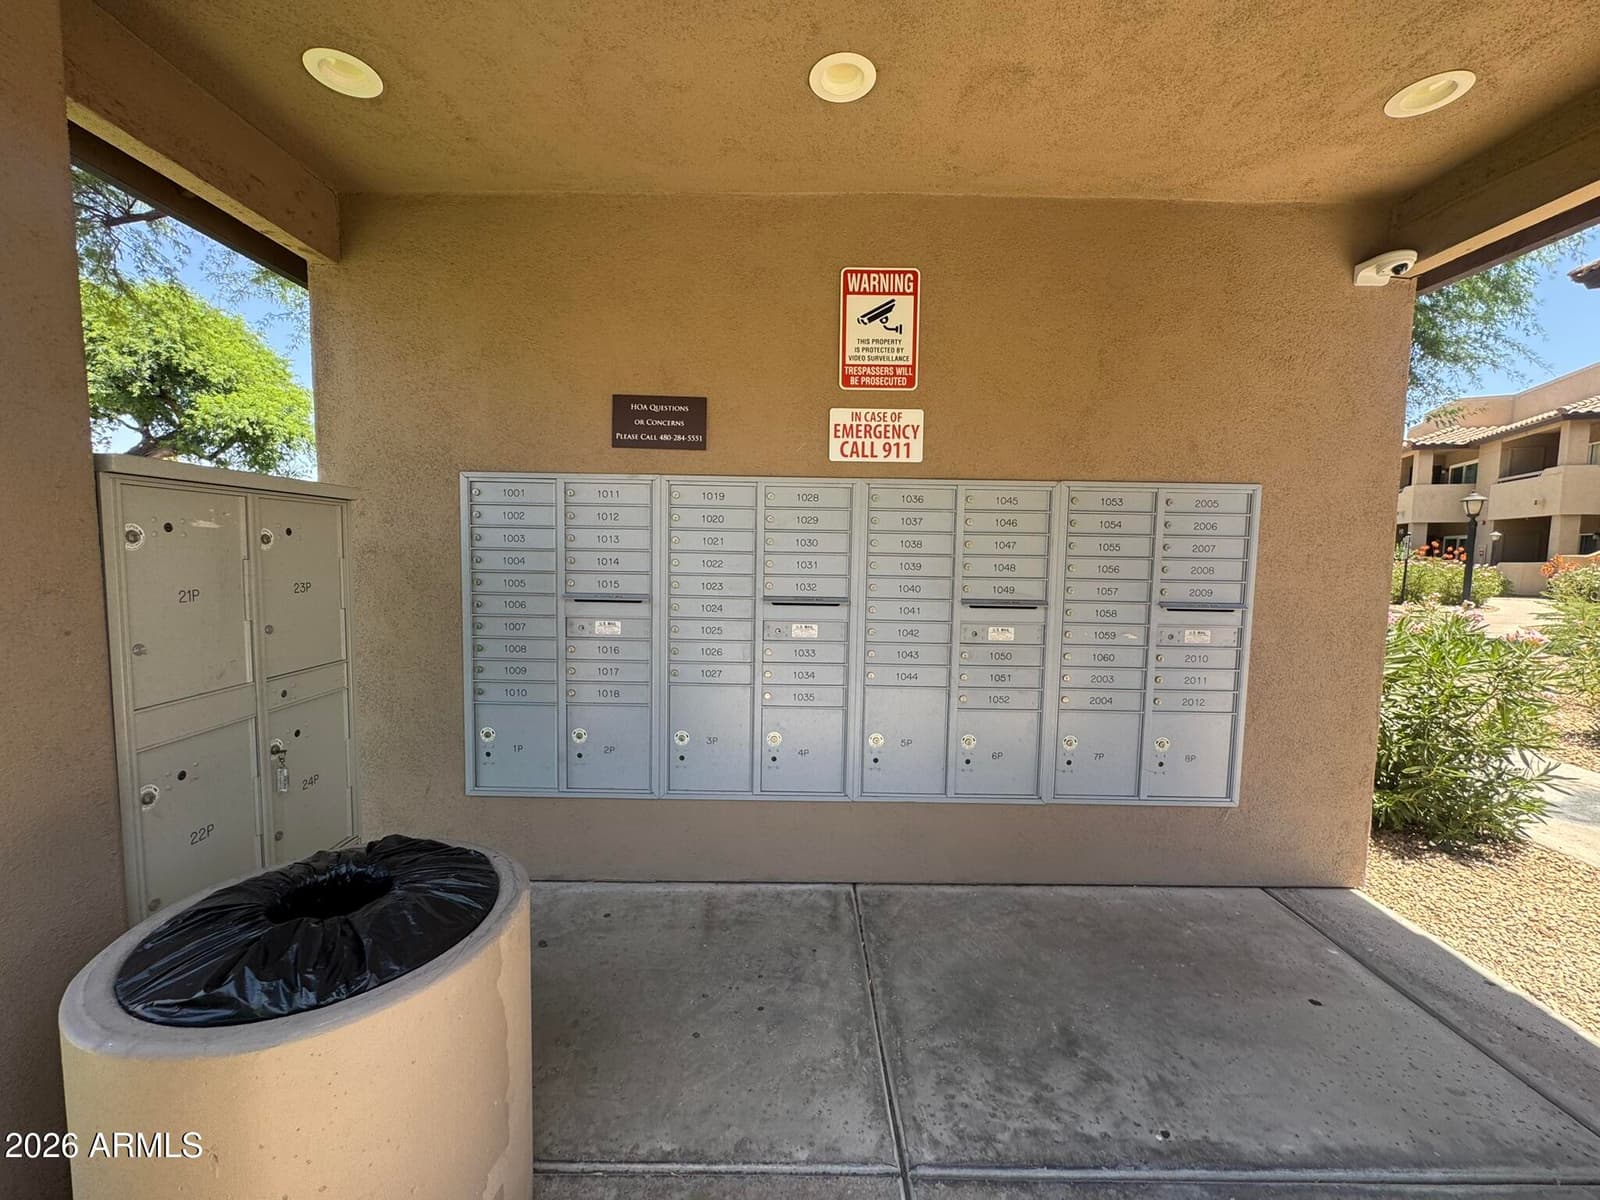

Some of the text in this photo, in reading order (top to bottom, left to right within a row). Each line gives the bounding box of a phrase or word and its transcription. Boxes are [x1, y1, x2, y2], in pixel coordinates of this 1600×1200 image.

[847, 272, 914, 293] WARNING
[844, 366, 913, 376] TRESPASSERS WILL
[850, 376, 907, 386] BE PROSECUTED
[630, 403, 648, 411] HOA
[851, 411, 903, 423] IN CASE OF
[833, 423, 921, 440] EMERGENCY
[659, 434, 703, 442] 480-284-5551
[840, 441, 911, 459] CALL 911
[503, 487, 525, 498] 1001
[597, 489, 620, 499] 1011
[701, 491, 726, 502] 1019
[796, 492, 820, 503] 1028
[901, 494, 925, 504] 1036
[996, 495, 1019, 506] 1045
[1101, 497, 1125, 507] 1053
[1194, 498, 1220, 509] 2005
[502, 511, 526, 521] 1002
[596, 511, 620, 522] 1012
[701, 514, 725, 524] 1020
[796, 515, 820, 525] 1029
[900, 516, 924, 527] 1037
[995, 518, 1018, 528] 1046
[1099, 519, 1122, 530] 1054
[1192, 521, 1219, 532] 2006
[503, 533, 526, 544] 1003
[596, 534, 620, 544] 1013
[702, 536, 724, 546] 1021
[795, 537, 819, 548] 1030
[900, 539, 923, 550] 1038
[994, 540, 1017, 551] 1047
[1098, 542, 1121, 552] 1055
[1191, 543, 1217, 554] 2007
[503, 556, 526, 566] 1004
[596, 557, 620, 567] 1014
[701, 559, 724, 569] 1022
[796, 560, 818, 570] 1031
[899, 561, 923, 572] 1039
[993, 562, 1017, 573] 1048
[1097, 564, 1120, 574] 1056
[1190, 565, 1216, 576] 2008
[293, 582, 311, 594] 23P
[503, 578, 527, 589] 1005
[597, 579, 621, 589] 1015
[700, 581, 725, 592] 1023
[795, 582, 817, 592] 1032
[898, 584, 922, 594] 1040
[992, 584, 1016, 595] 1049
[1096, 586, 1119, 597] 1057
[1188, 587, 1214, 598] 2009
[178, 588, 200, 603] 21P
[503, 599, 527, 610] 1006
[701, 603, 724, 613] 1024
[898, 606, 921, 616] 1041
[1095, 608, 1118, 619] 1058
[503, 621, 527, 632] 1007
[700, 625, 724, 636] 1025
[897, 628, 920, 638] 1042
[1094, 630, 1117, 641] 1059
[504, 643, 528, 654] 1008
[597, 645, 621, 655] 1016
[700, 647, 724, 657] 1026
[793, 648, 817, 658] 1033
[896, 649, 920, 660] 1043
[989, 651, 1013, 661] 1050
[1092, 652, 1116, 663] 1060
[1184, 654, 1209, 664] 2010
[504, 665, 528, 676] 1009
[597, 666, 620, 677] 1017
[700, 669, 723, 679] 1027
[793, 670, 816, 681] 1034
[896, 672, 919, 681] 1044
[989, 673, 1012, 683] 1051
[1090, 674, 1115, 685] 2003
[1183, 675, 1207, 686] 2011
[504, 687, 528, 697] 1010
[597, 688, 621, 699] 1018
[792, 692, 816, 702] 1035
[988, 695, 1011, 705] 1052
[1089, 696, 1113, 706] 2004
[1181, 697, 1206, 707] 2012
[705, 736, 719, 745] 3P
[899, 738, 913, 748] 5P
[513, 744, 524, 753] 1P
[603, 745, 616, 755] 2P
[797, 748, 810, 758] 4P
[991, 751, 1004, 761] 6P
[1093, 752, 1105, 761] 7P
[1184, 754, 1197, 764] 8P
[302, 774, 319, 790] 24P
[190, 824, 215, 845] 22P
